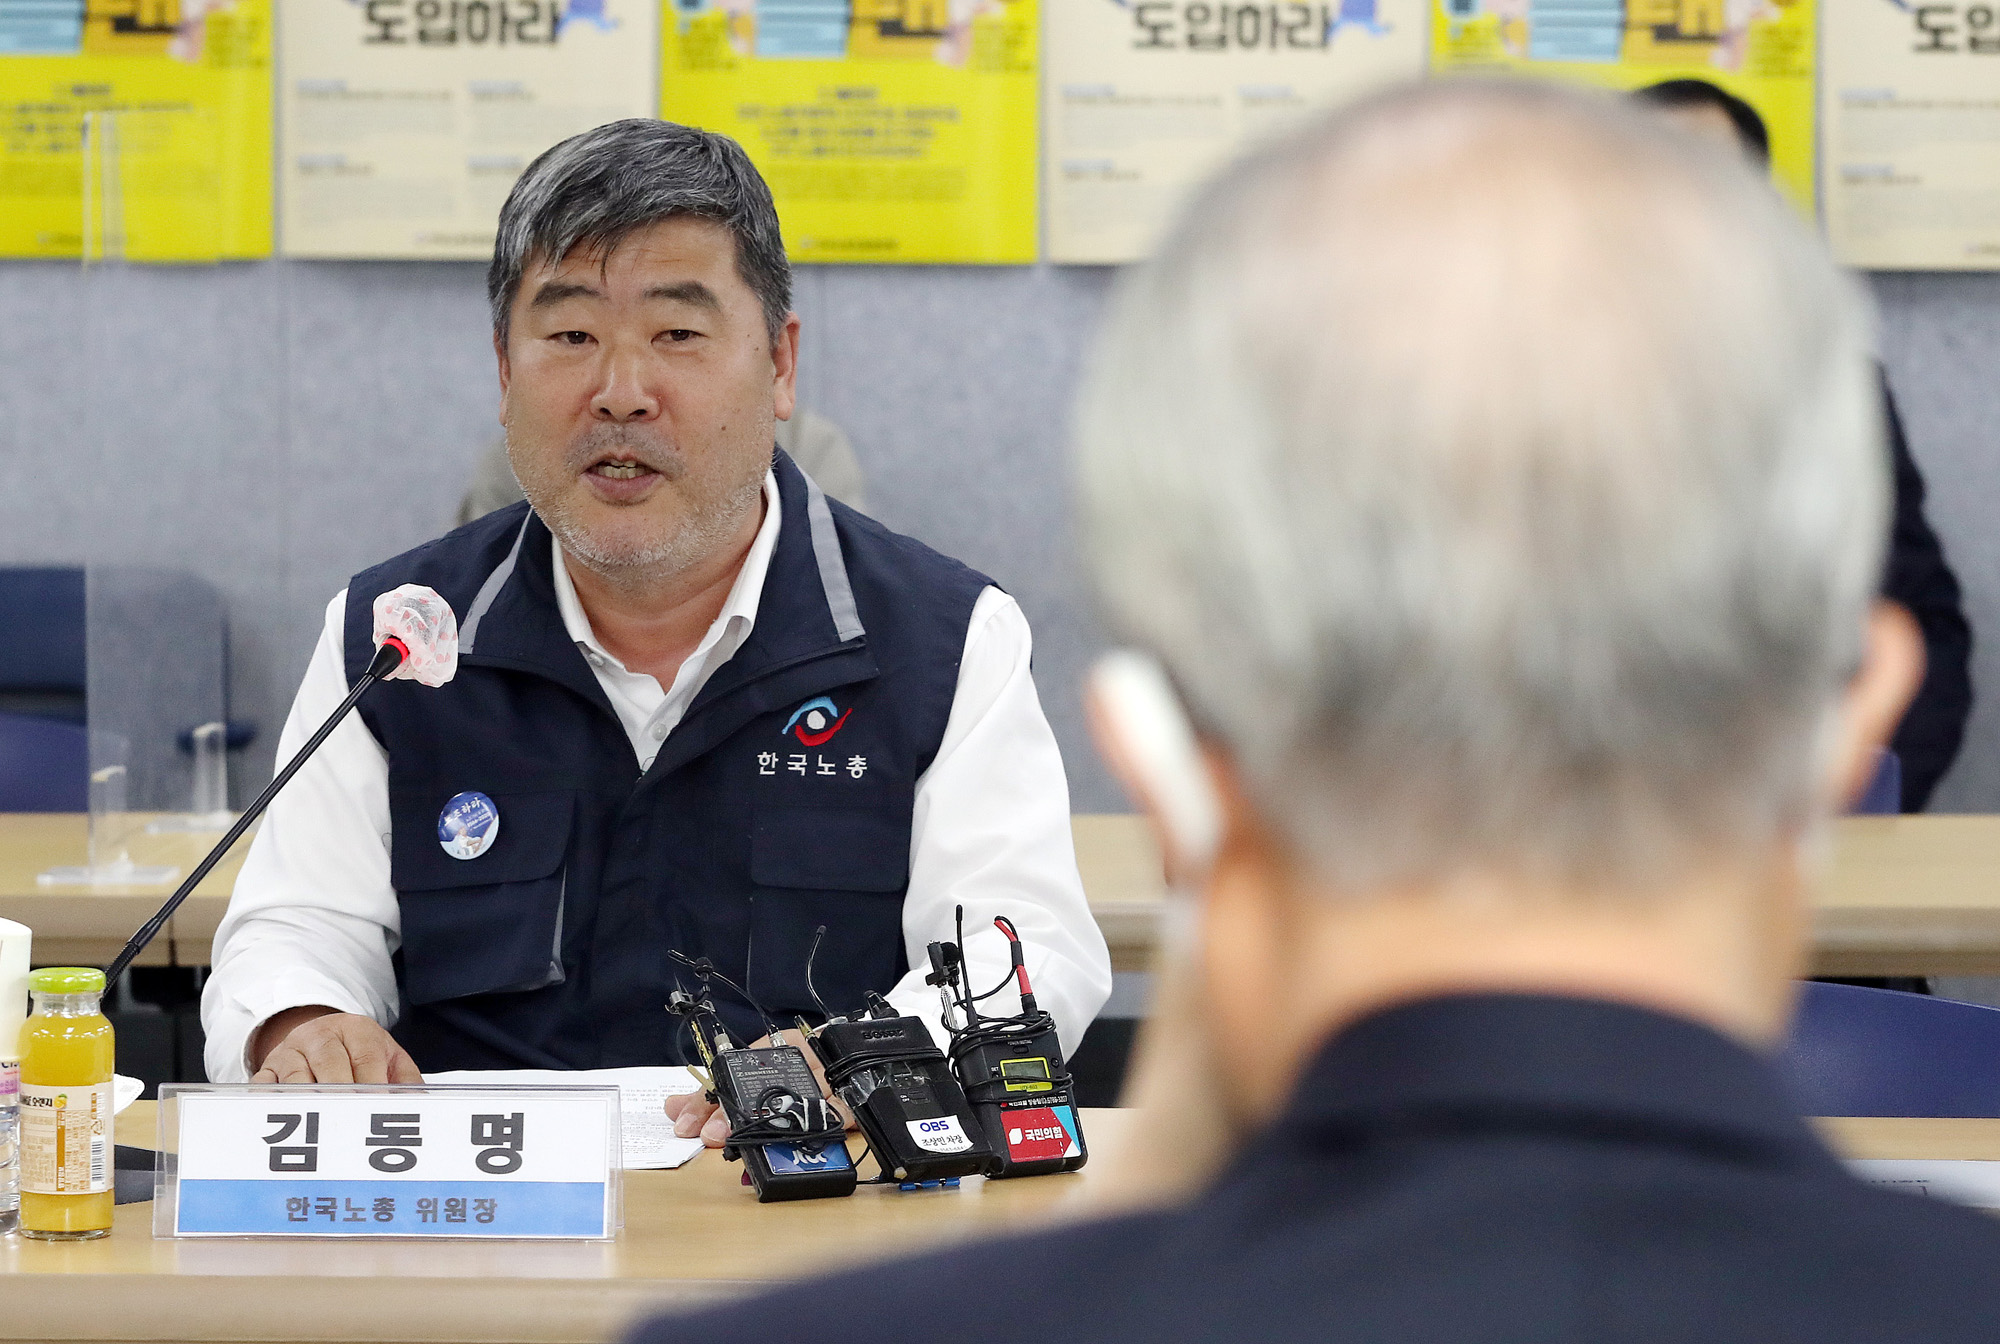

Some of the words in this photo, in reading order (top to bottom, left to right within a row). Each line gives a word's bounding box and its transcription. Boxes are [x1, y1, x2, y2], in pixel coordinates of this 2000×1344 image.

[757, 751, 868, 779] 한국노총
[920, 1120, 949, 1132] OBS
[1024, 1126, 1063, 1141] 국민의힘
[262, 1112, 319, 1172] 김
[365, 1113, 423, 1173] 동
[470, 1112, 524, 1175] 명
[286, 1196, 396, 1223] 한국노총
[416, 1196, 497, 1224] 위원장
